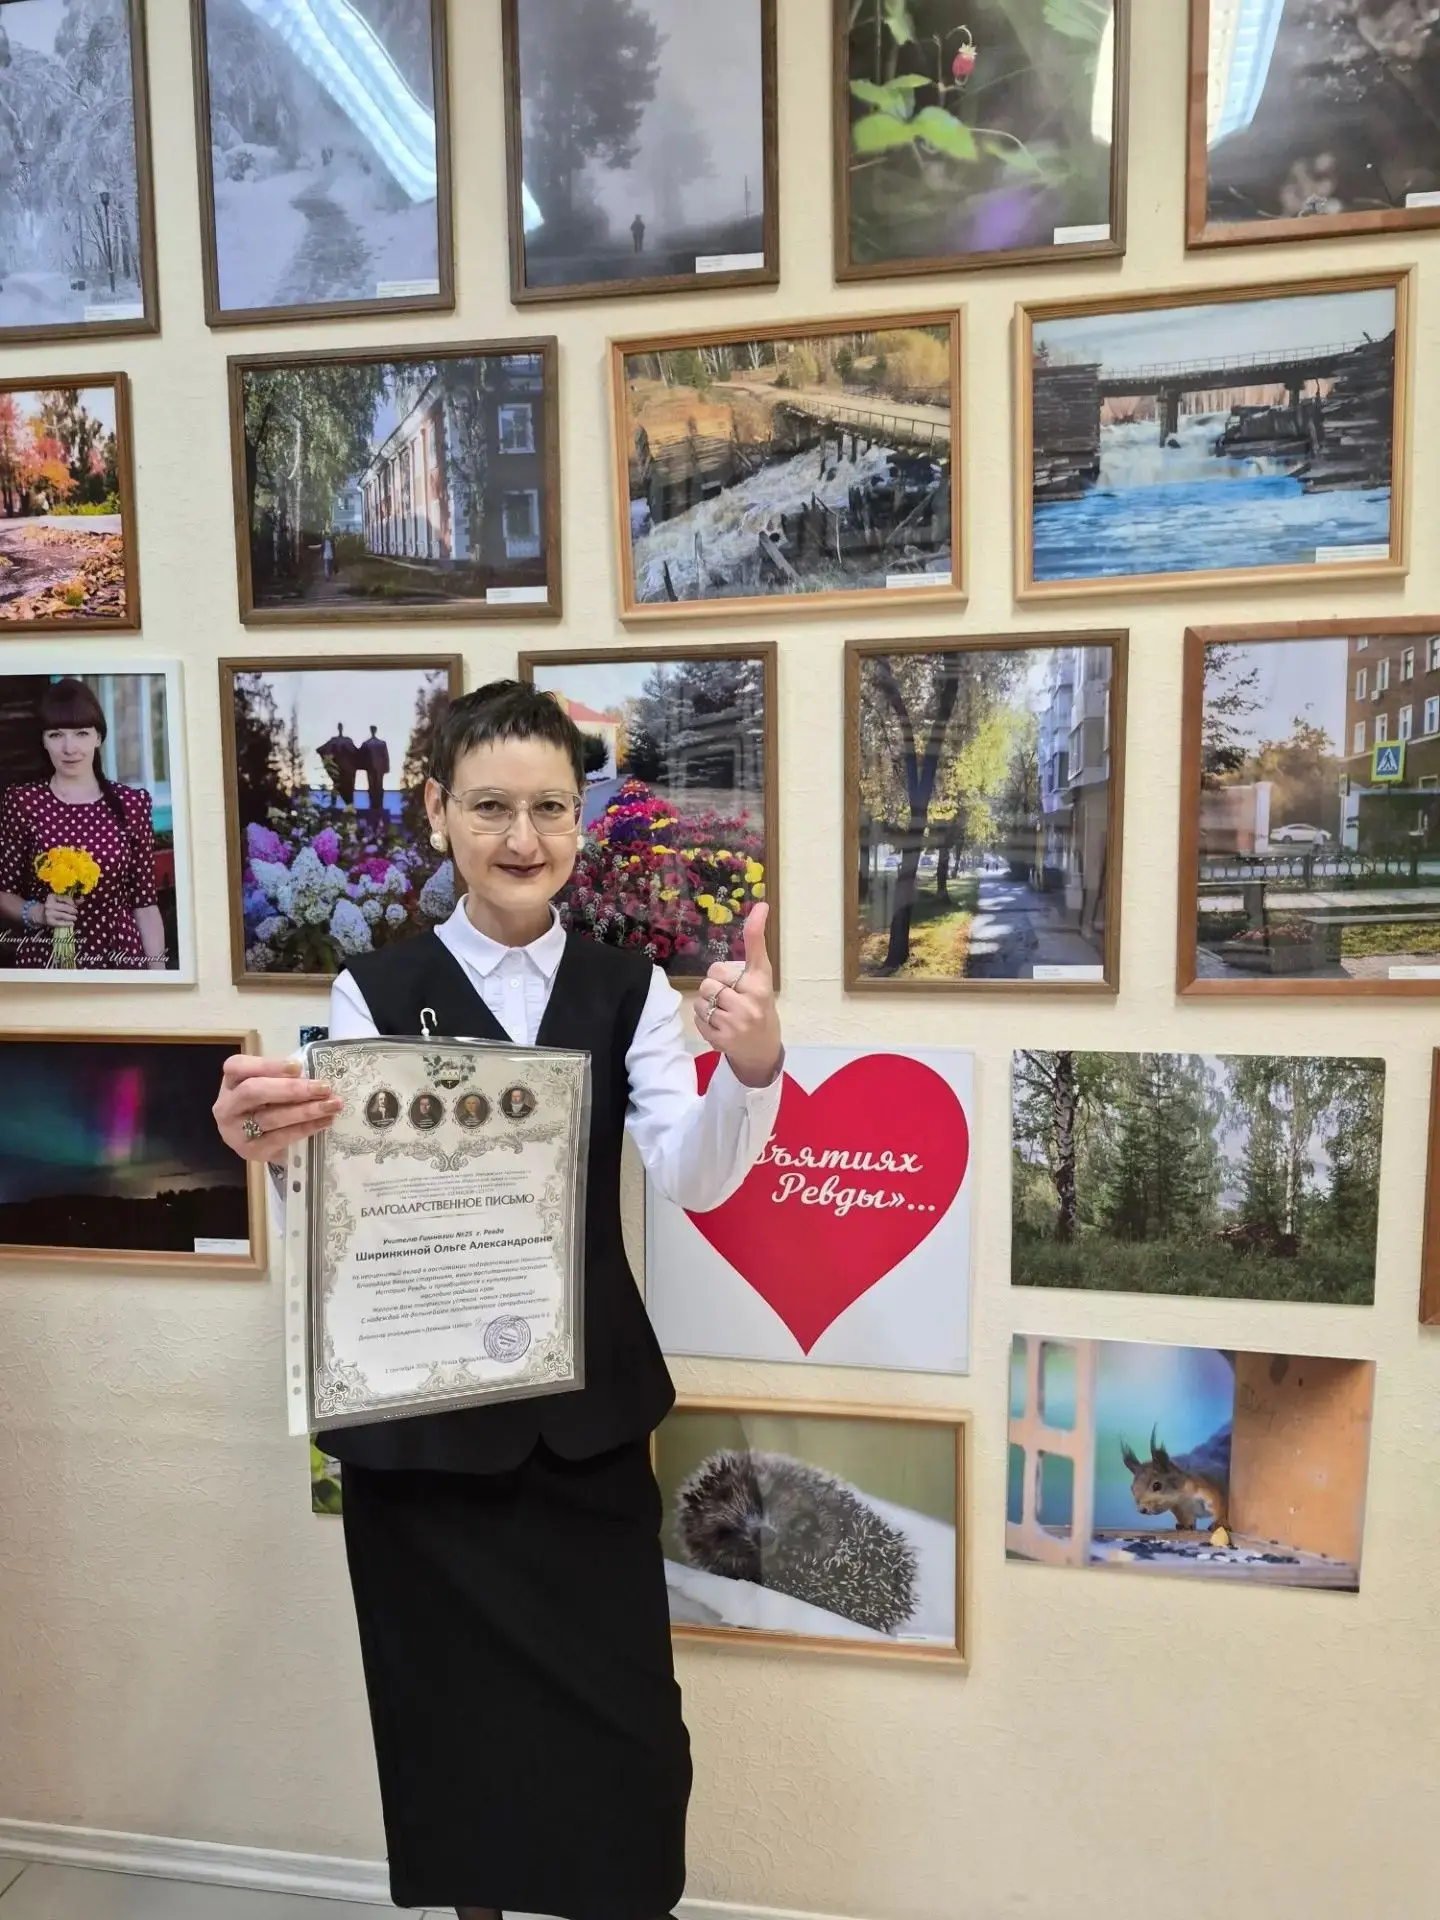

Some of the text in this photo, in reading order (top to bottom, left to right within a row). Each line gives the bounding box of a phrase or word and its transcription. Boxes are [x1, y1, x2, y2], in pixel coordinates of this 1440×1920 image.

[361, 1193, 534, 1217] БЛАГОДАРСТВЕННОЕ ПИСЬМО
[356, 1235, 553, 1261] Ширинкиной Ольге Александровне
